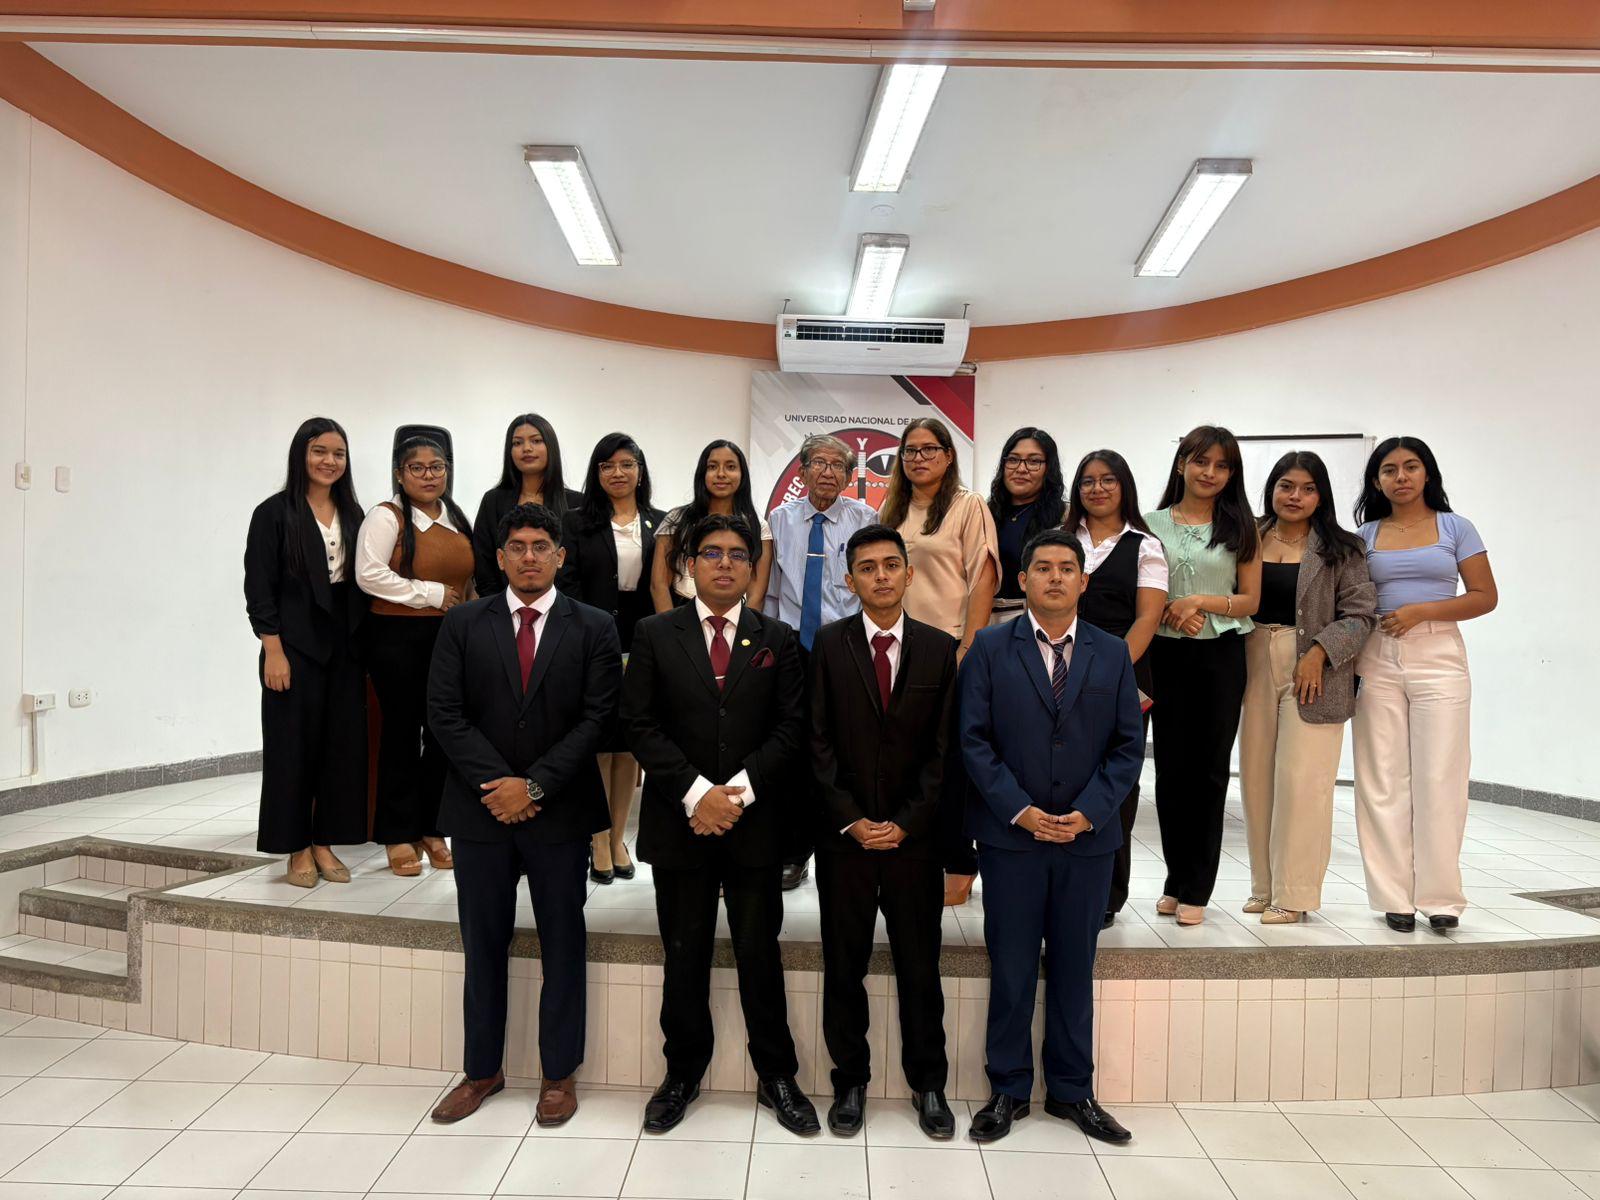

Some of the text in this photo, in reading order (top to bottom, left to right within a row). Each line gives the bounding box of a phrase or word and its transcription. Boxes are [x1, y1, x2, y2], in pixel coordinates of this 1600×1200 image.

[784, 414, 847, 424] UNIVERSIDAD
[848, 416, 895, 425] NACIONAL
[897, 418, 909, 426] DE
[781, 438, 869, 505] REC Y
